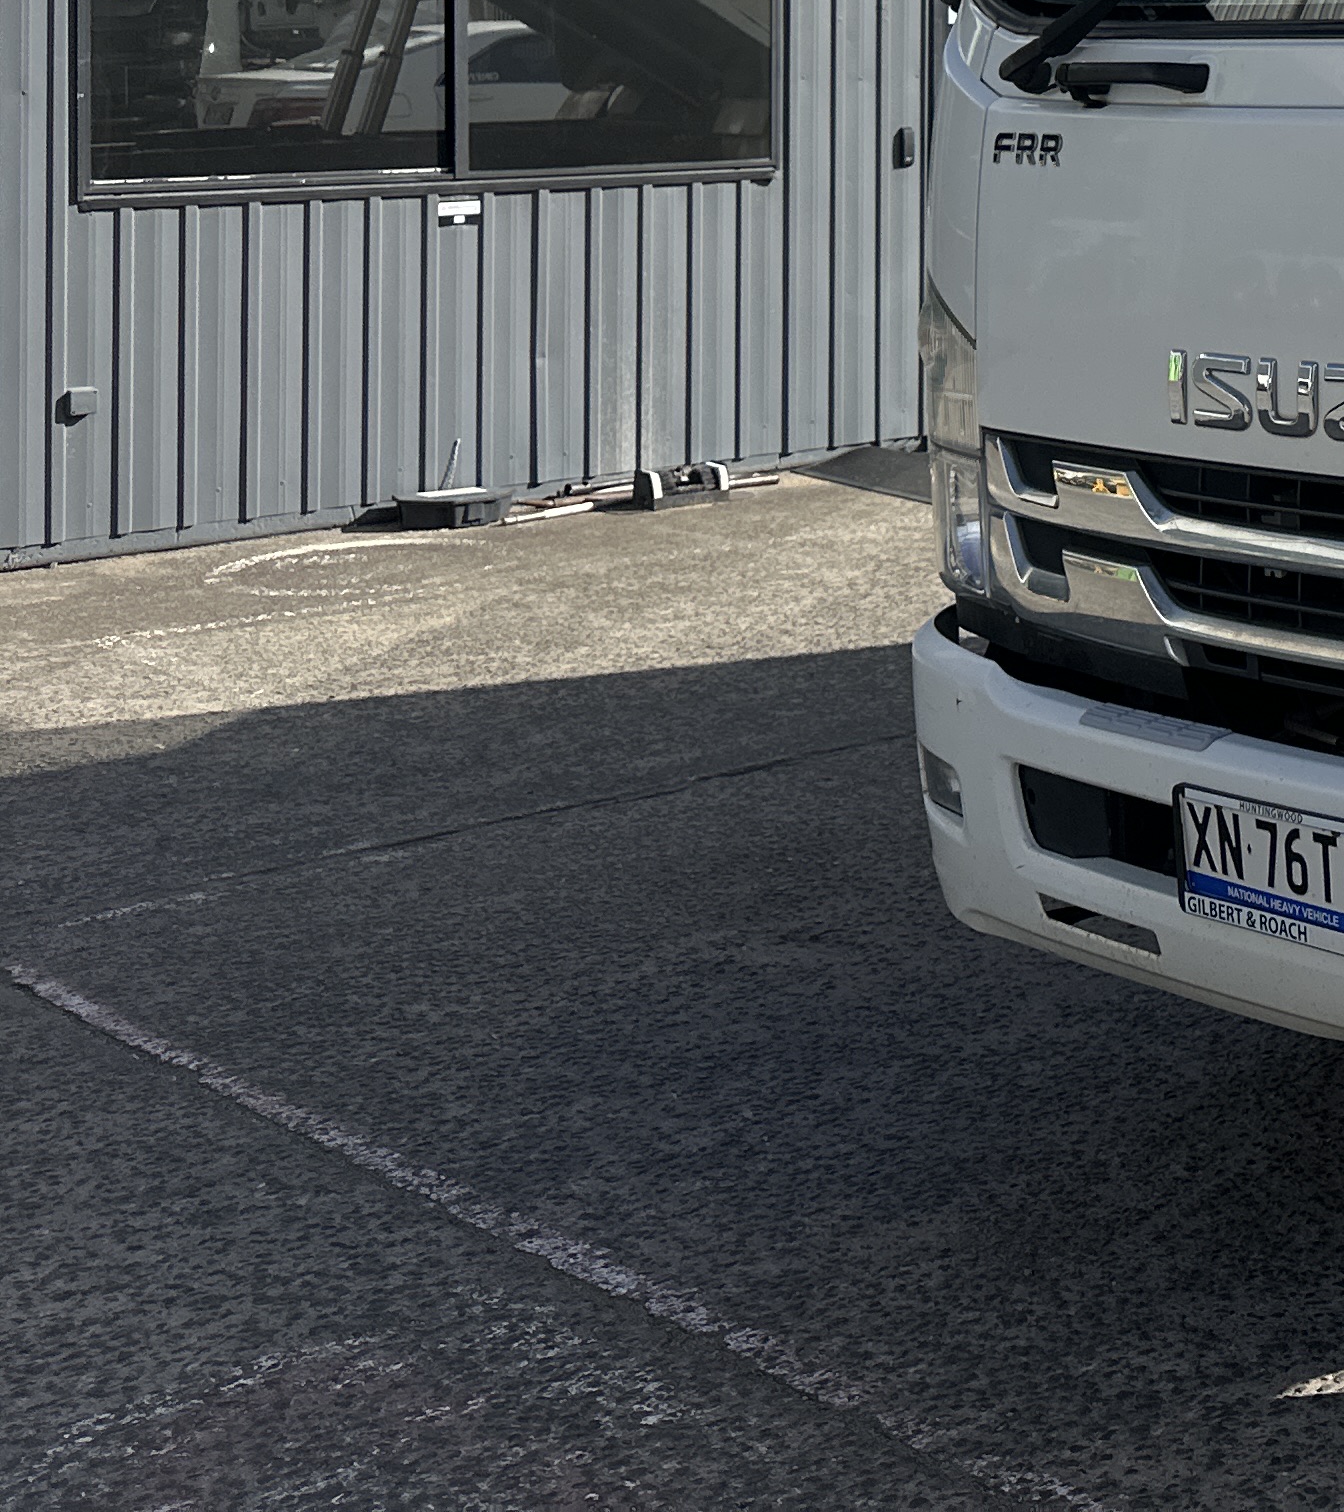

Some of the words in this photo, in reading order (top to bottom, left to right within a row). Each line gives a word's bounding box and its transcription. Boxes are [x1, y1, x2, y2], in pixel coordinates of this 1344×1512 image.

[993, 131, 1064, 166] FRR
[1239, 800, 1304, 824] HUNTINGWOOD
[1186, 895, 1244, 926] GILBERT
[1245, 910, 1257, 929] &
[1258, 913, 1308, 943] ROACH
[1227, 885, 1270, 909] NATIONAL
[1269, 898, 1301, 917] HEAVY
[1301, 905, 1341, 928] VEHICLE
